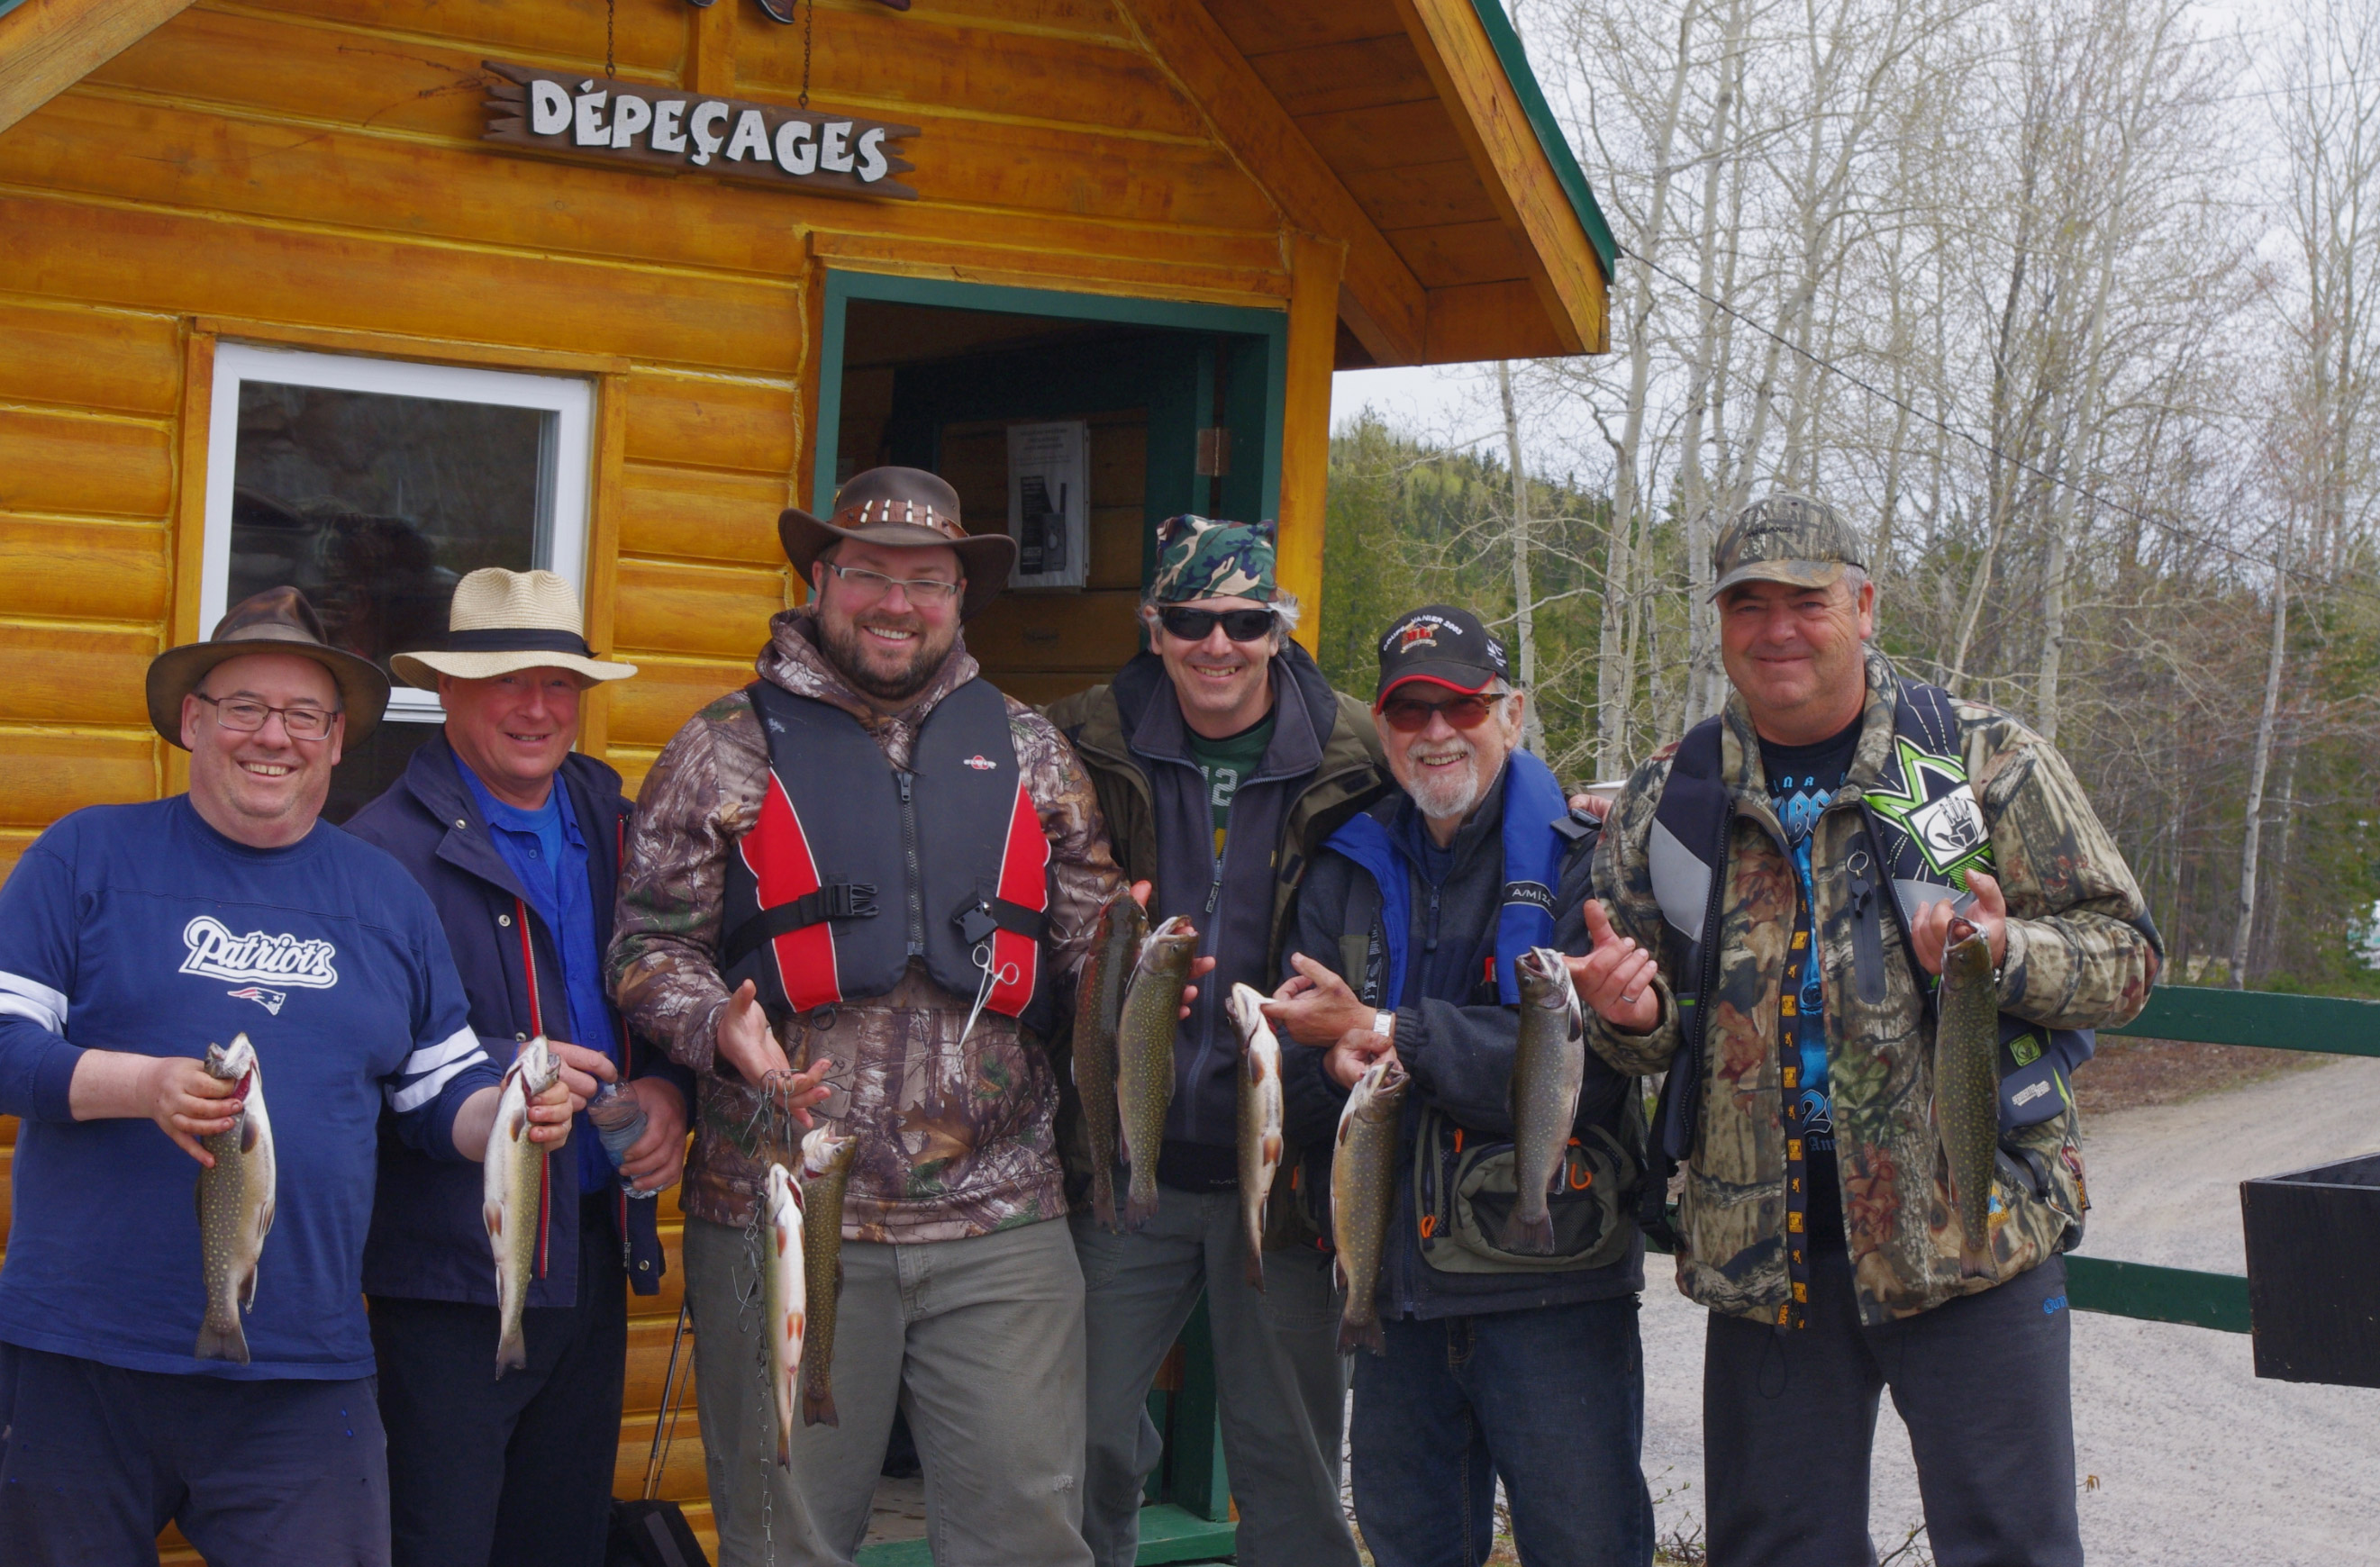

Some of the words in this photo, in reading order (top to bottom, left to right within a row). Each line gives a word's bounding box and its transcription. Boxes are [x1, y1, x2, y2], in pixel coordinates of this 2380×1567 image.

[530, 78, 888, 183] DÉPEÇAGES
[1383, 626, 1406, 652] COUPE
[1411, 614, 1445, 625] VANIER
[178, 915, 338, 989] Patriots
